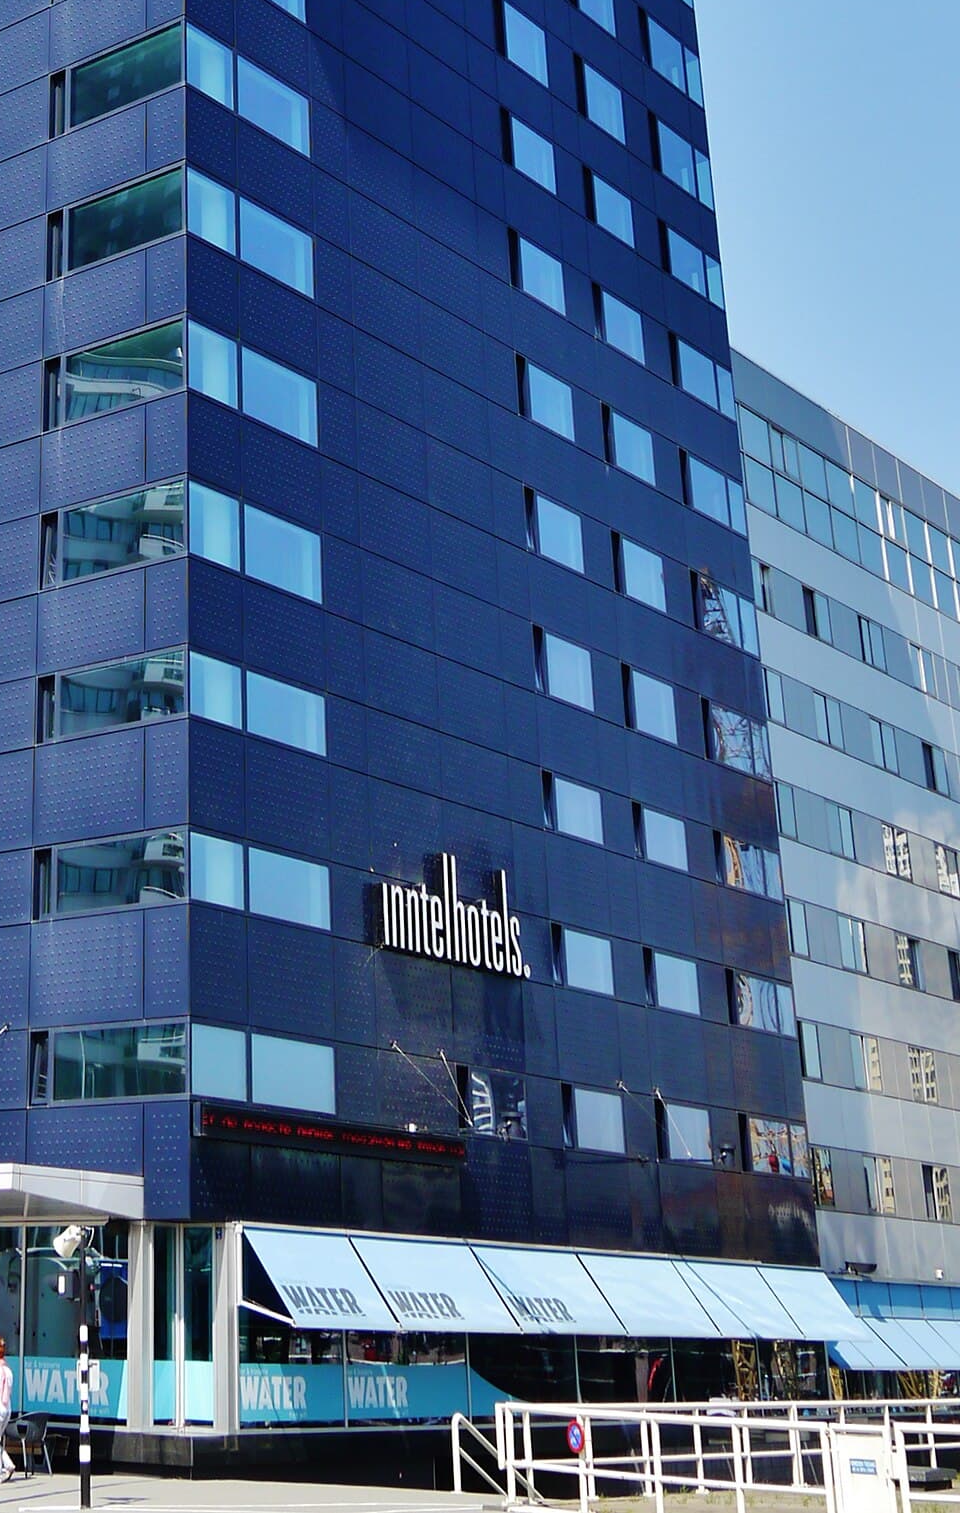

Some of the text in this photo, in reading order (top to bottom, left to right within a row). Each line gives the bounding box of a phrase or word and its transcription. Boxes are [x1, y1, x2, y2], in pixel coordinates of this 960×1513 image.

[280, 1285, 366, 1316] WATER
[387, 1289, 465, 1320] WATER
[506, 1295, 577, 1323] WATER
[24, 1368, 110, 1406] WATR
[240, 1375, 307, 1410] WATER
[347, 1375, 409, 1409] WATER
